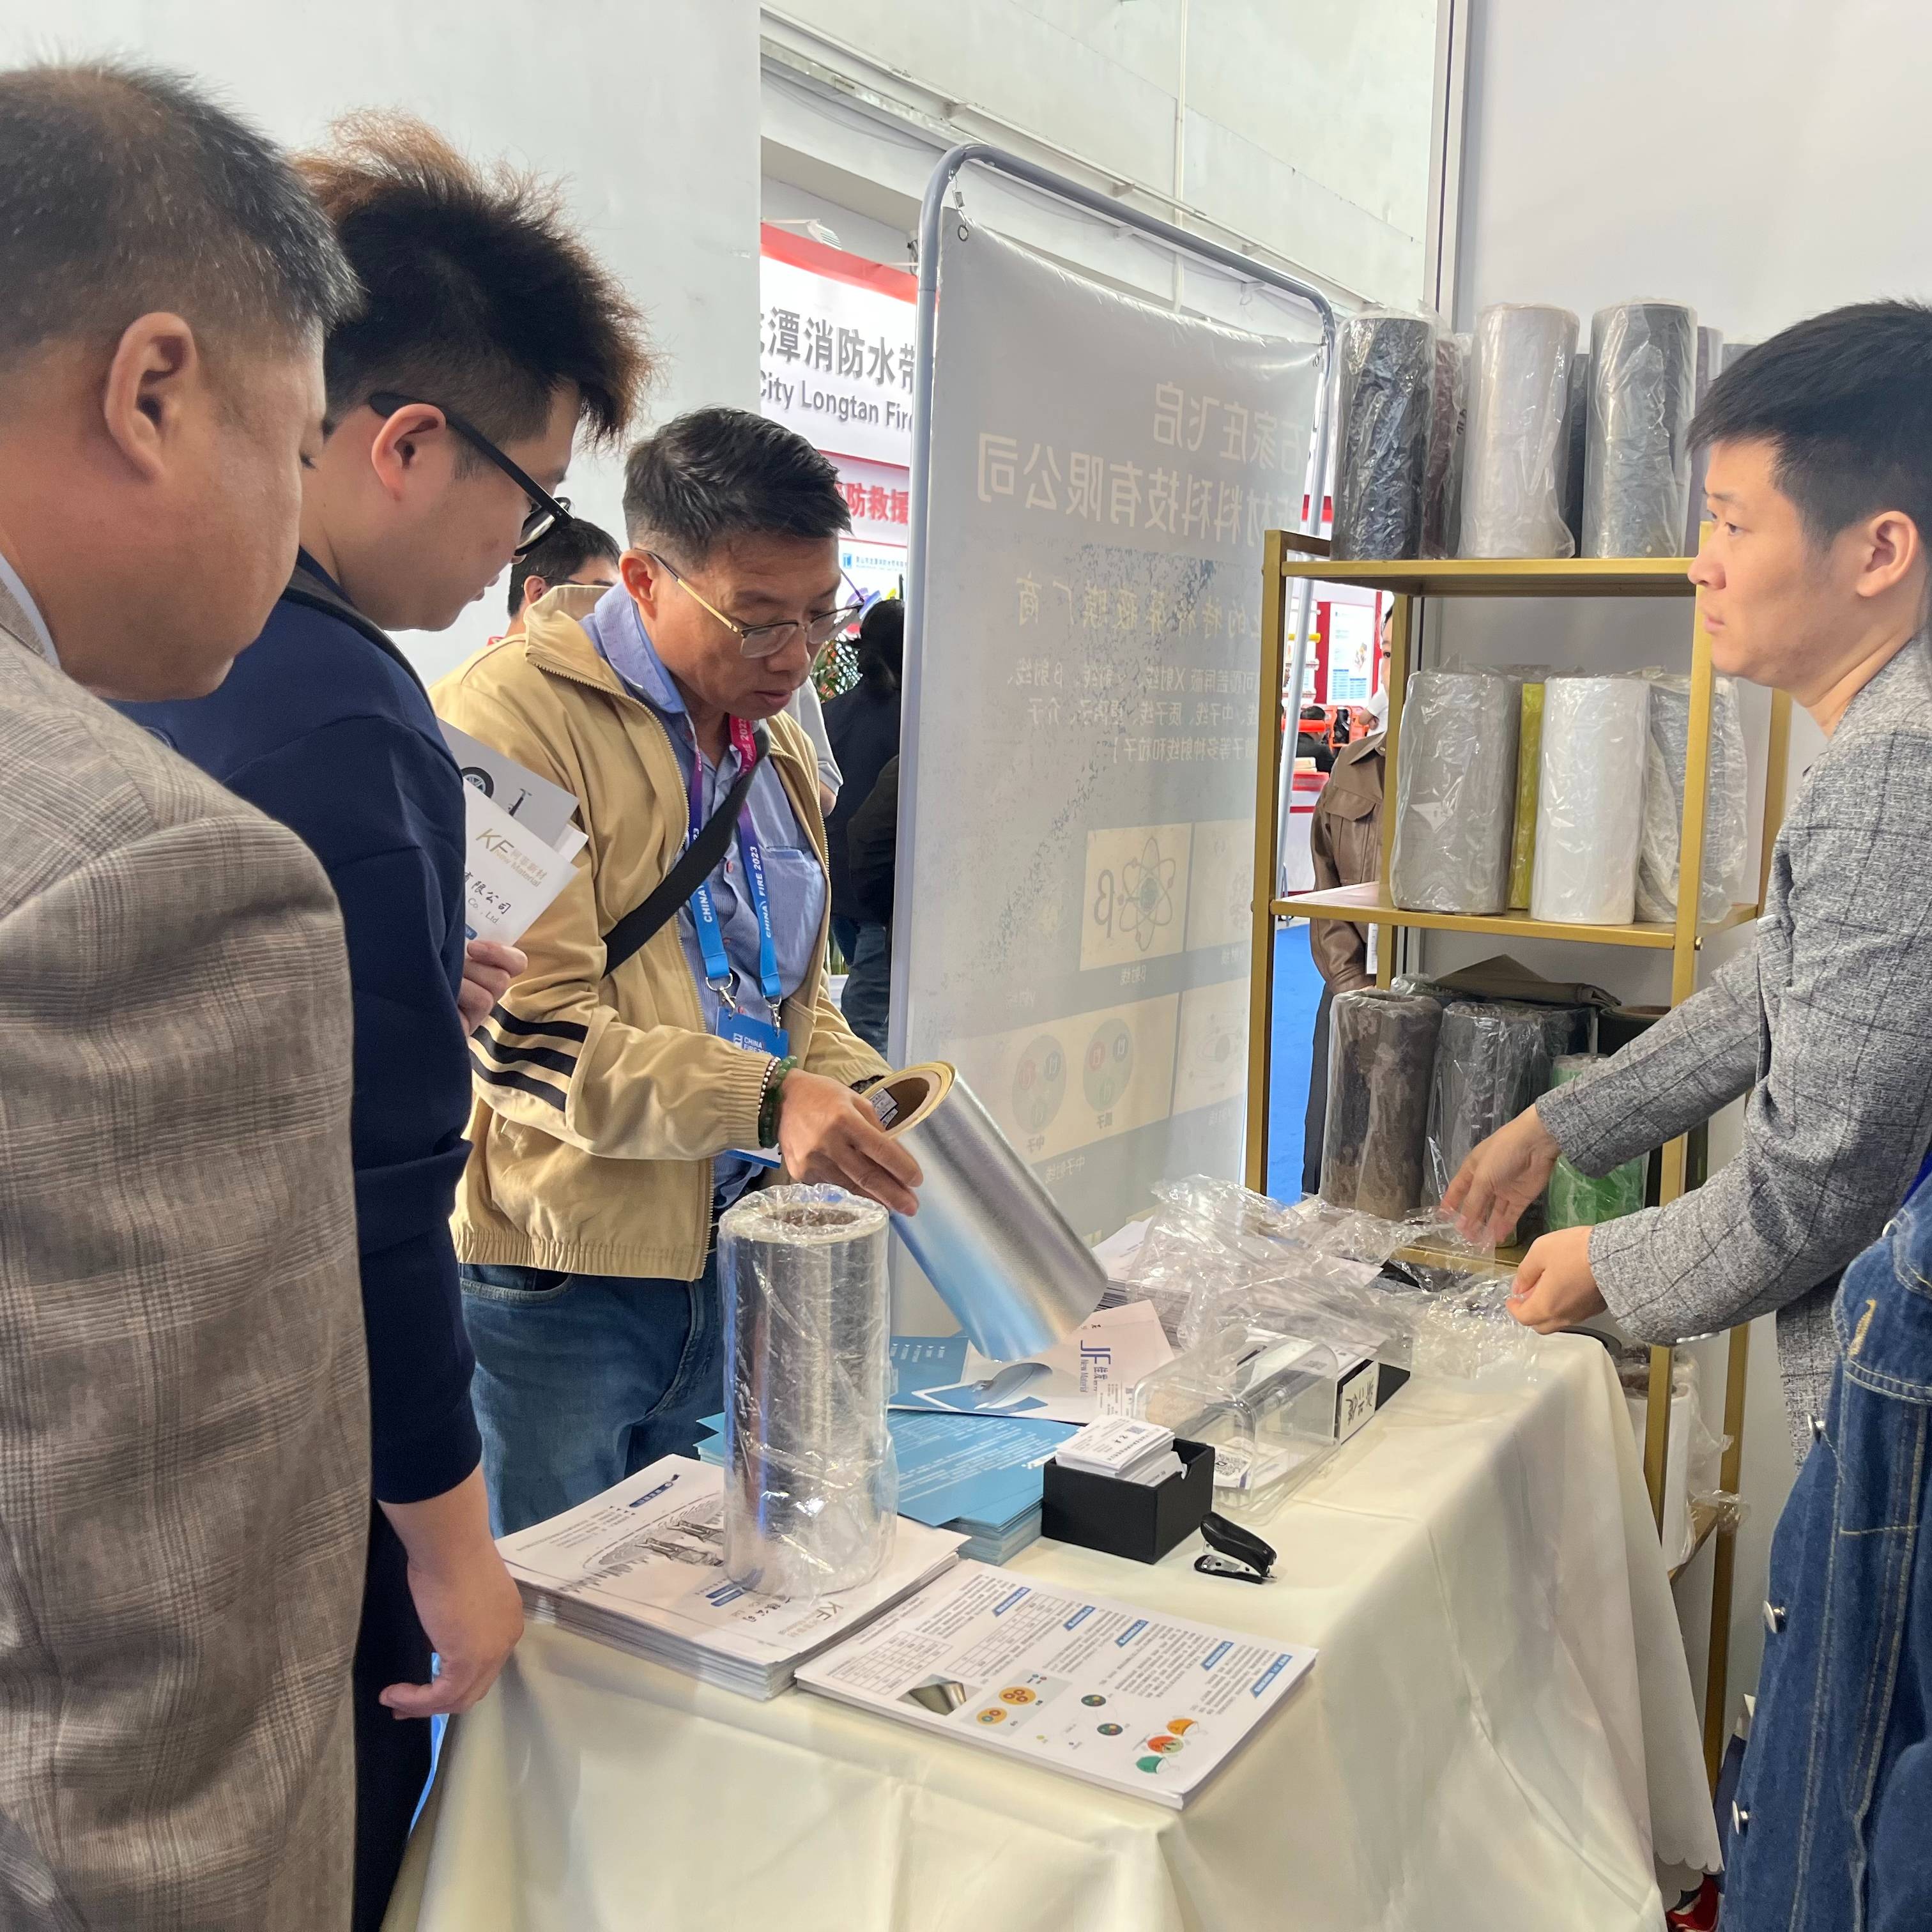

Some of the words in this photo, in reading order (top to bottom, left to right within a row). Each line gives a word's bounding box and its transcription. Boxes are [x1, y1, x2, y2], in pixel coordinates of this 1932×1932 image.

[760, 306, 914, 394] 潭消防水带
[801, 379, 878, 422] Longtan
[886, 401, 912, 433] Fir
[835, 482, 909, 526] 防救援
[475, 828, 515, 852] KF
[749, 846, 762, 871] 2023
[510, 861, 542, 887] Material
[755, 873, 766, 897] FIRE
[698, 889, 713, 923] CHINA
[744, 1036, 763, 1048] CHINA
